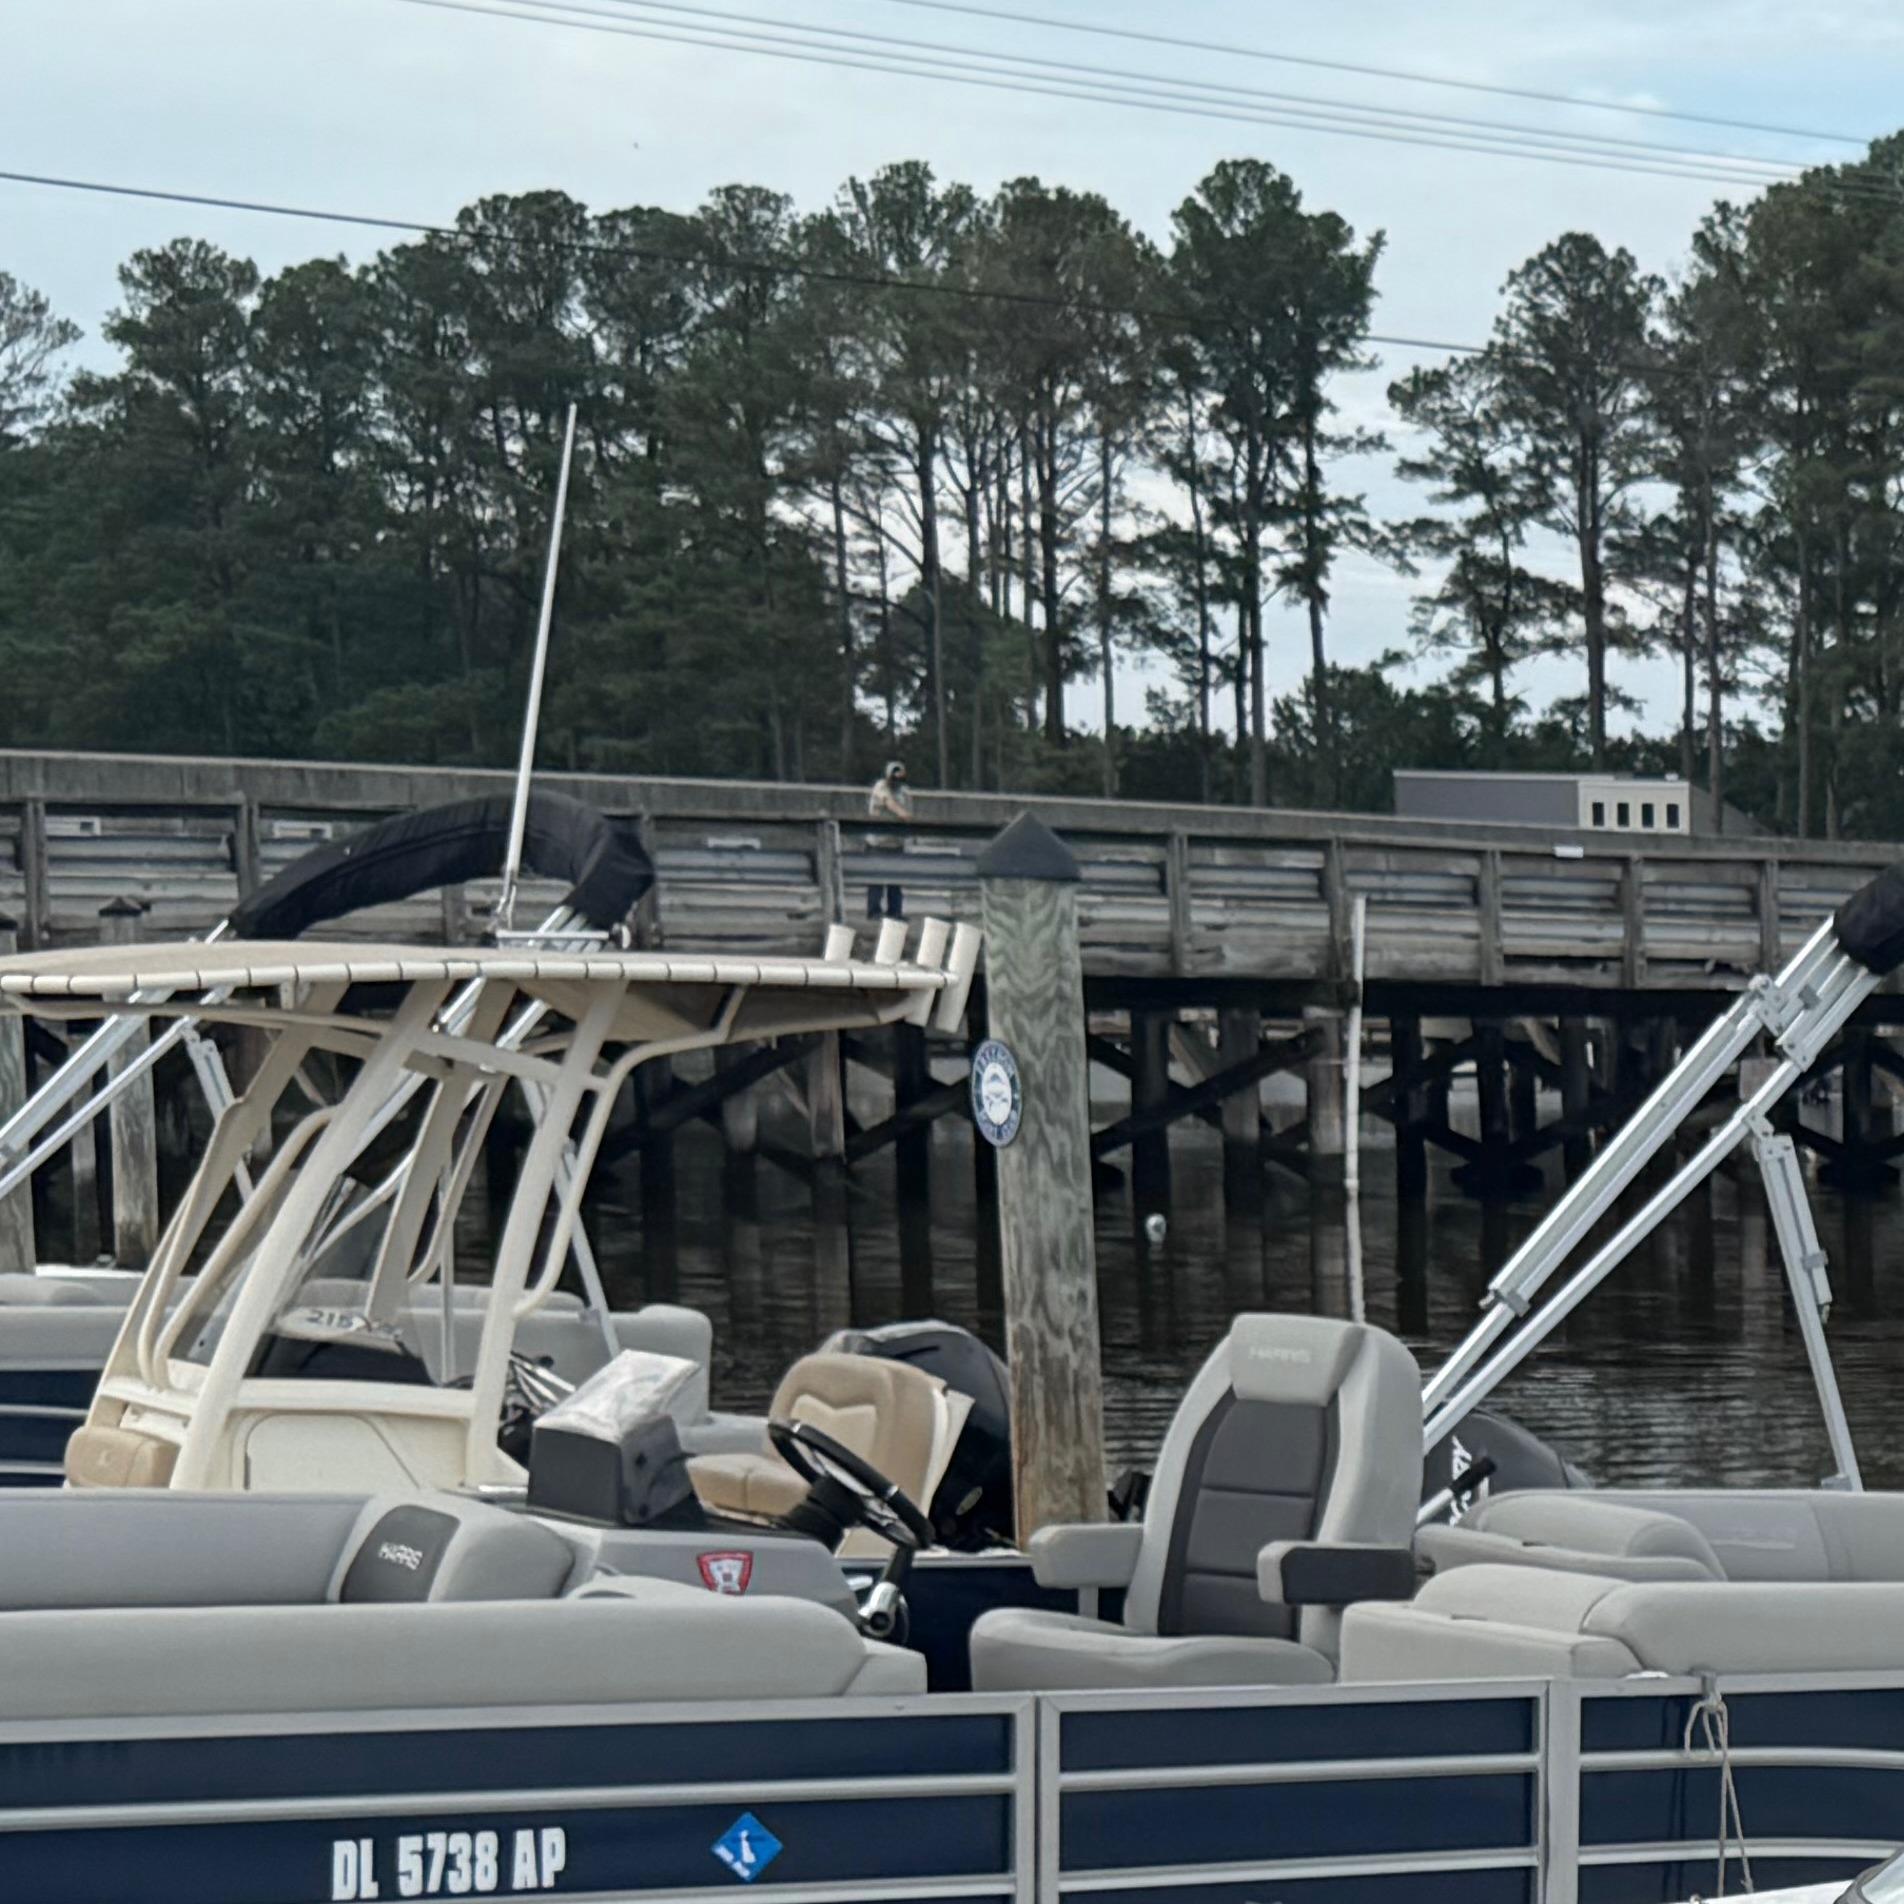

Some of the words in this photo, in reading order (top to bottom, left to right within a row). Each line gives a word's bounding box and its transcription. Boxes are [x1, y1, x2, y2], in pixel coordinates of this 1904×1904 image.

[331, 1838, 379, 1901] DL
[397, 1830, 499, 1897] 5738
[511, 1826, 567, 1891] AP
